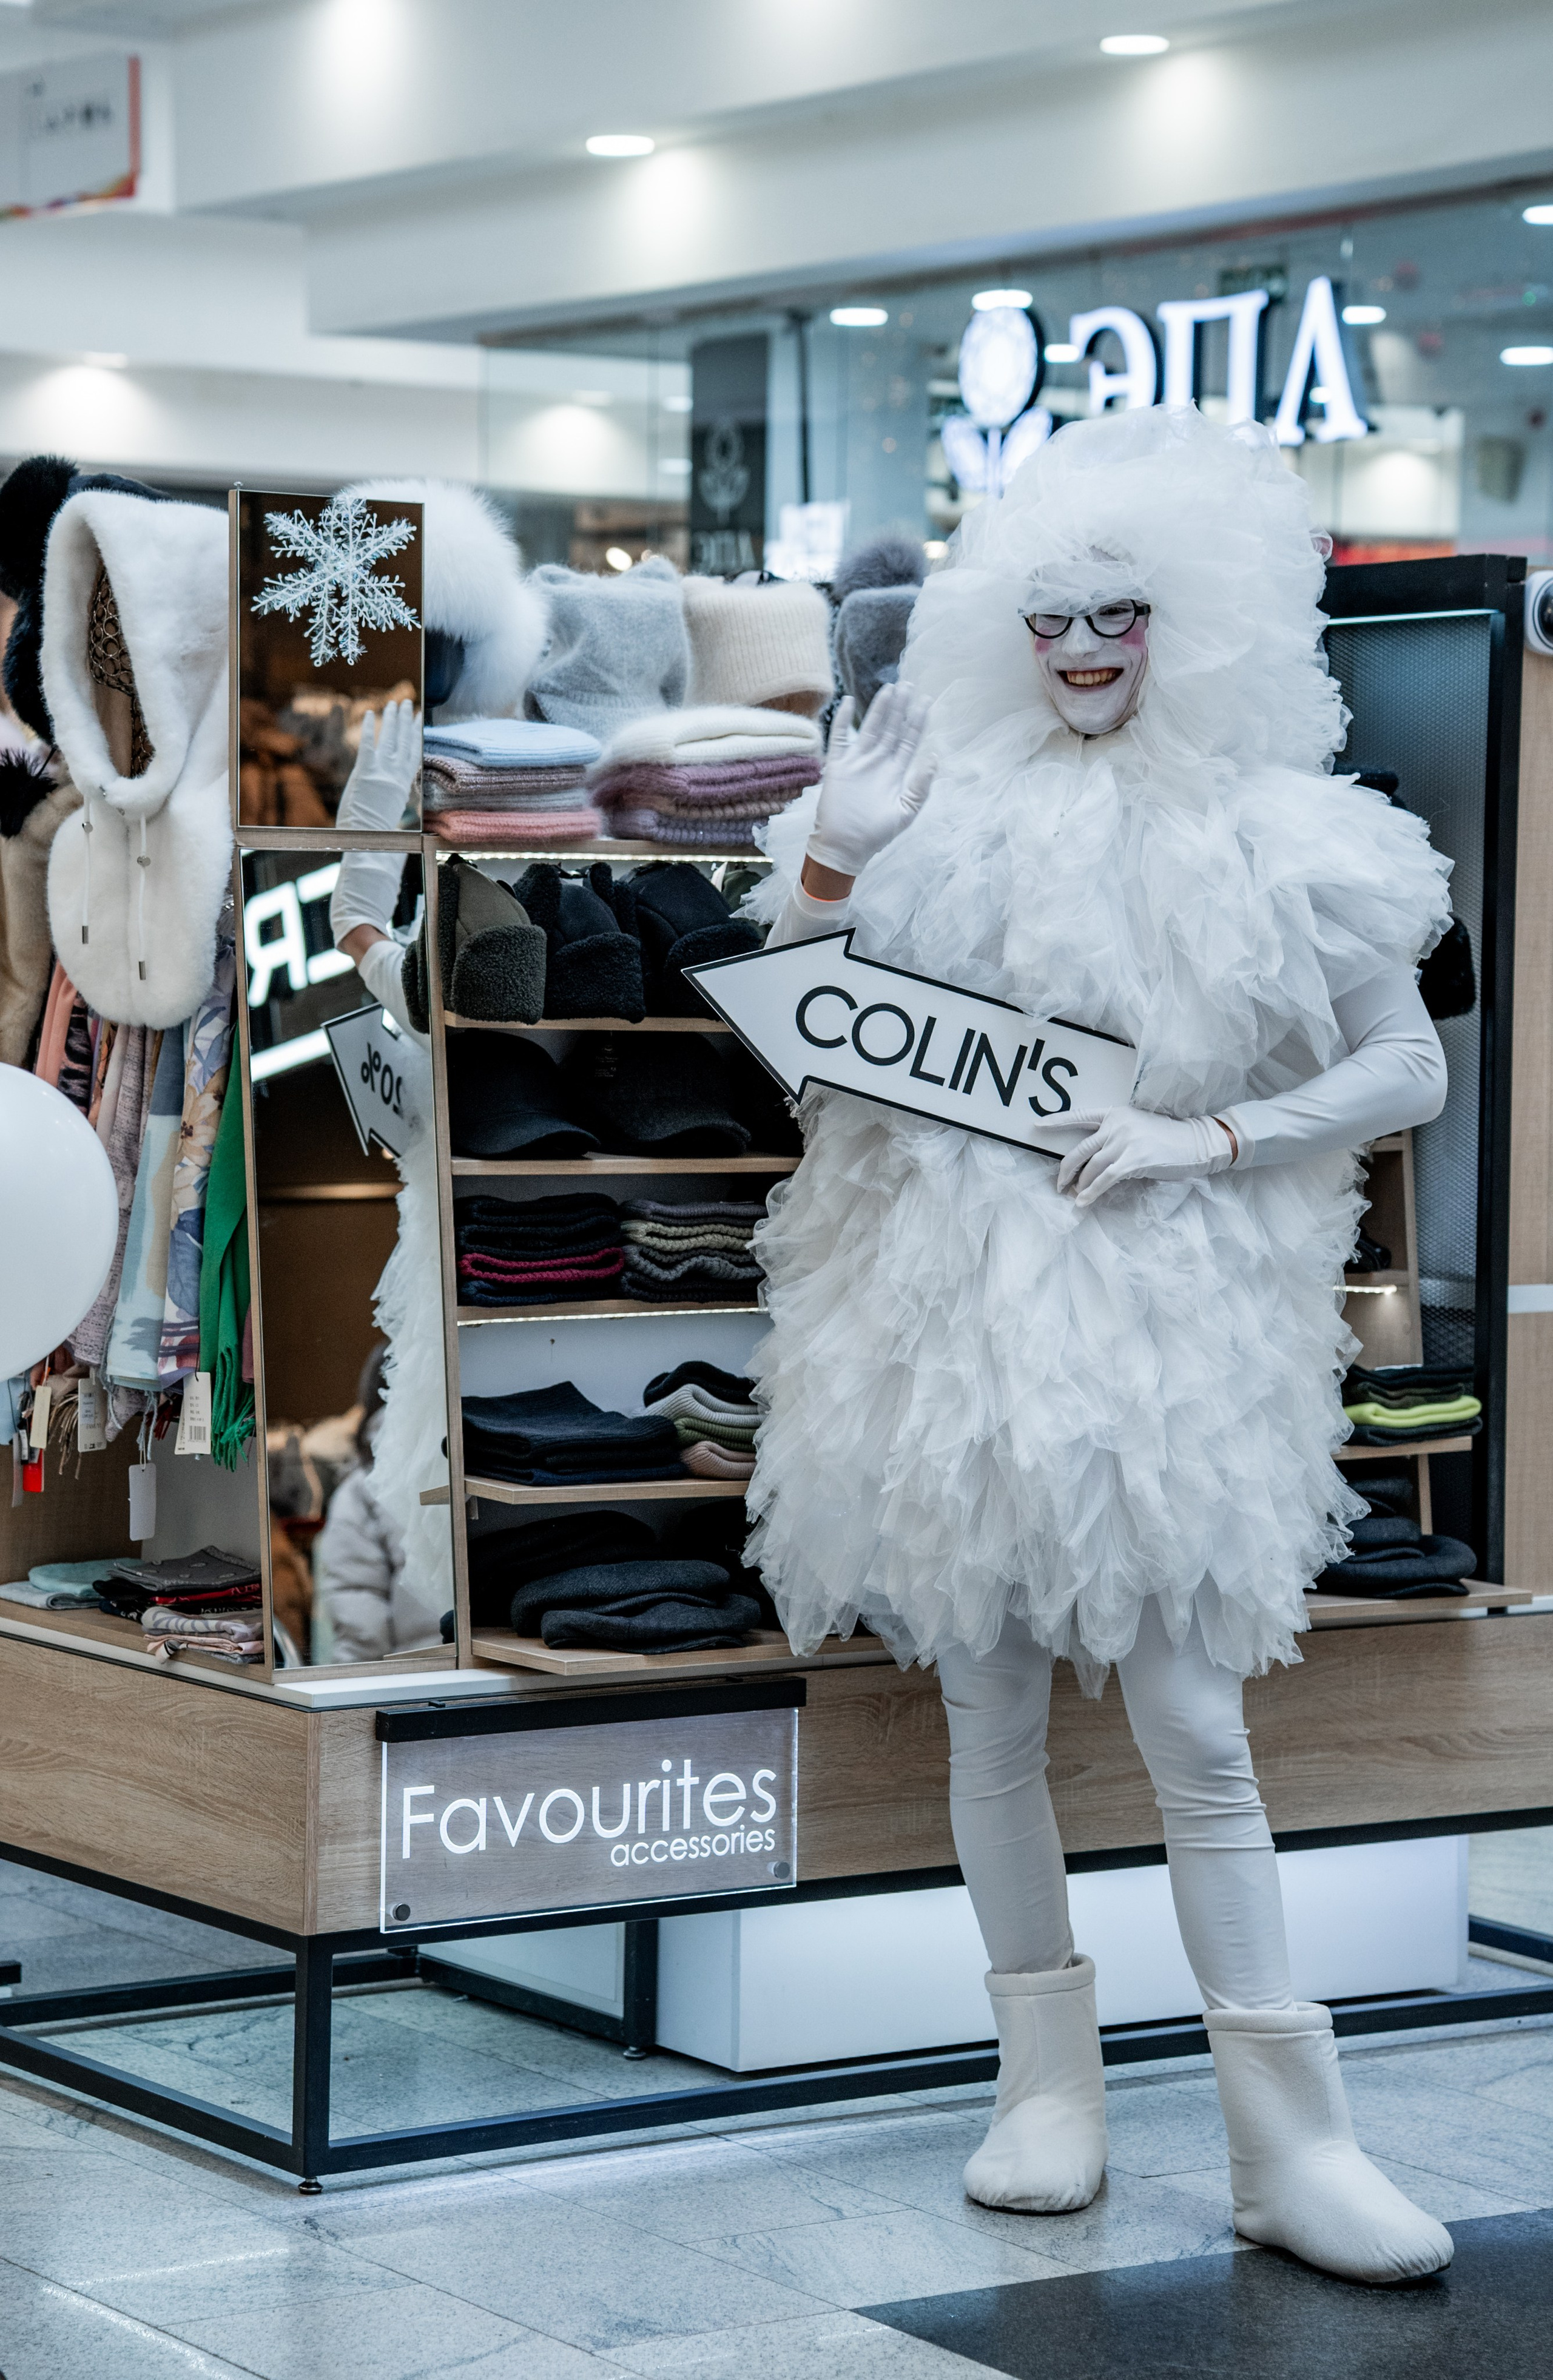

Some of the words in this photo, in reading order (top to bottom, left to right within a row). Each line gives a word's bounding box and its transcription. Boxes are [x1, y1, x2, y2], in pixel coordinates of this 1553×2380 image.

[795, 985, 1079, 1117] COLIN'S
[402, 1759, 777, 1859] Favourites
[610, 1824, 775, 1867] accessories
